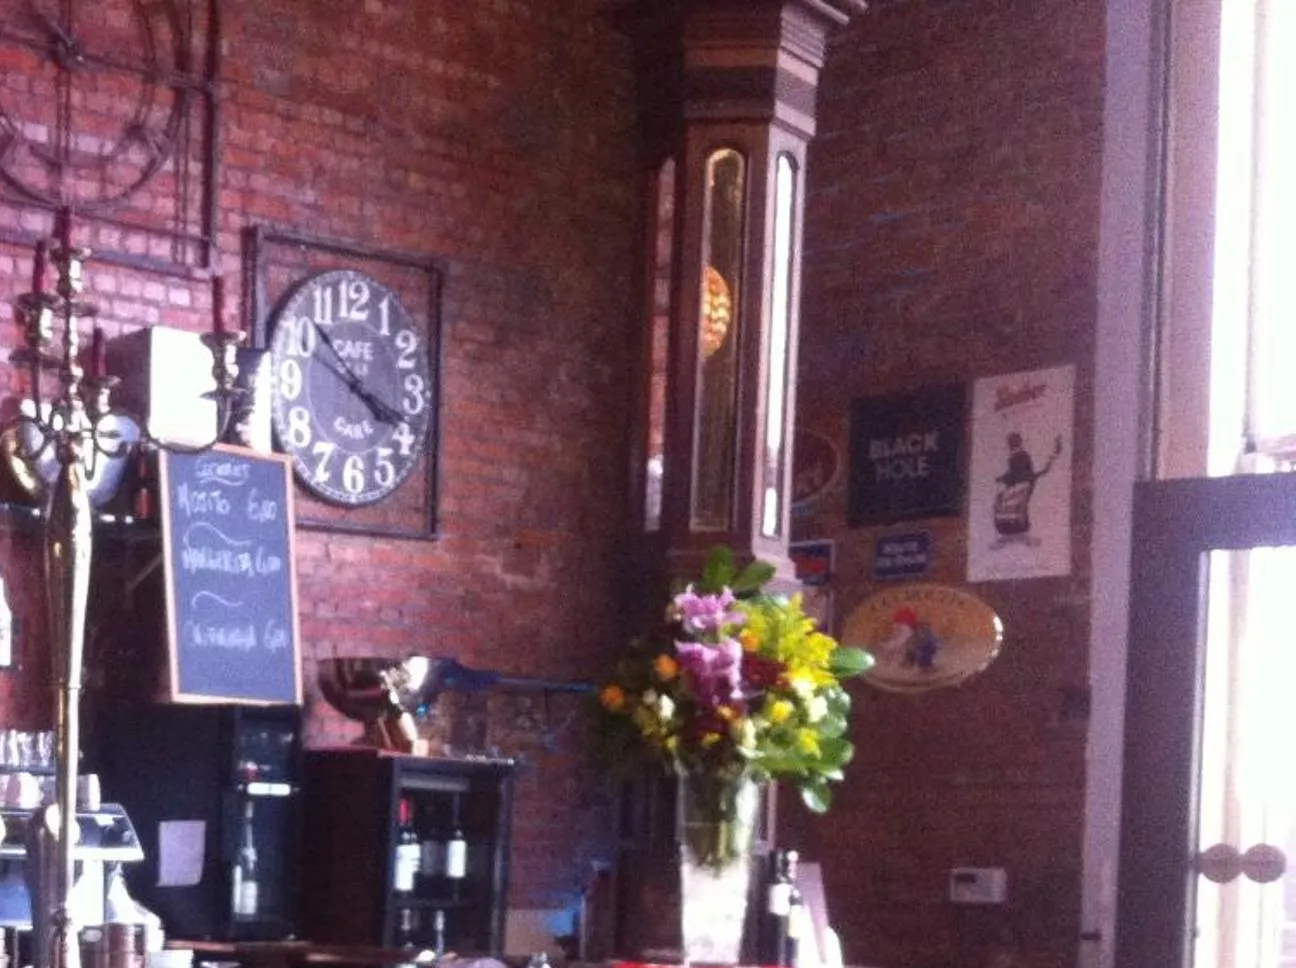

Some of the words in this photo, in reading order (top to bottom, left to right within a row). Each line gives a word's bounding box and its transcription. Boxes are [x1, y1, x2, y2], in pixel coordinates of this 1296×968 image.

[313, 286, 334, 325] 11
[339, 281, 370, 320] 12
[378, 297, 390, 335] 1
[280, 316, 316, 358] 10
[395, 329, 417, 368] 2
[280, 359, 302, 400] 9
[403, 374, 424, 414] 3
[289, 407, 312, 447] 8
[392, 422, 415, 455] 4
[867, 430, 940, 460] BLACK
[313, 442, 337, 483] 7
[343, 456, 365, 493] 6
[374, 447, 395, 486] 5
[876, 456, 931, 484] HOLE
